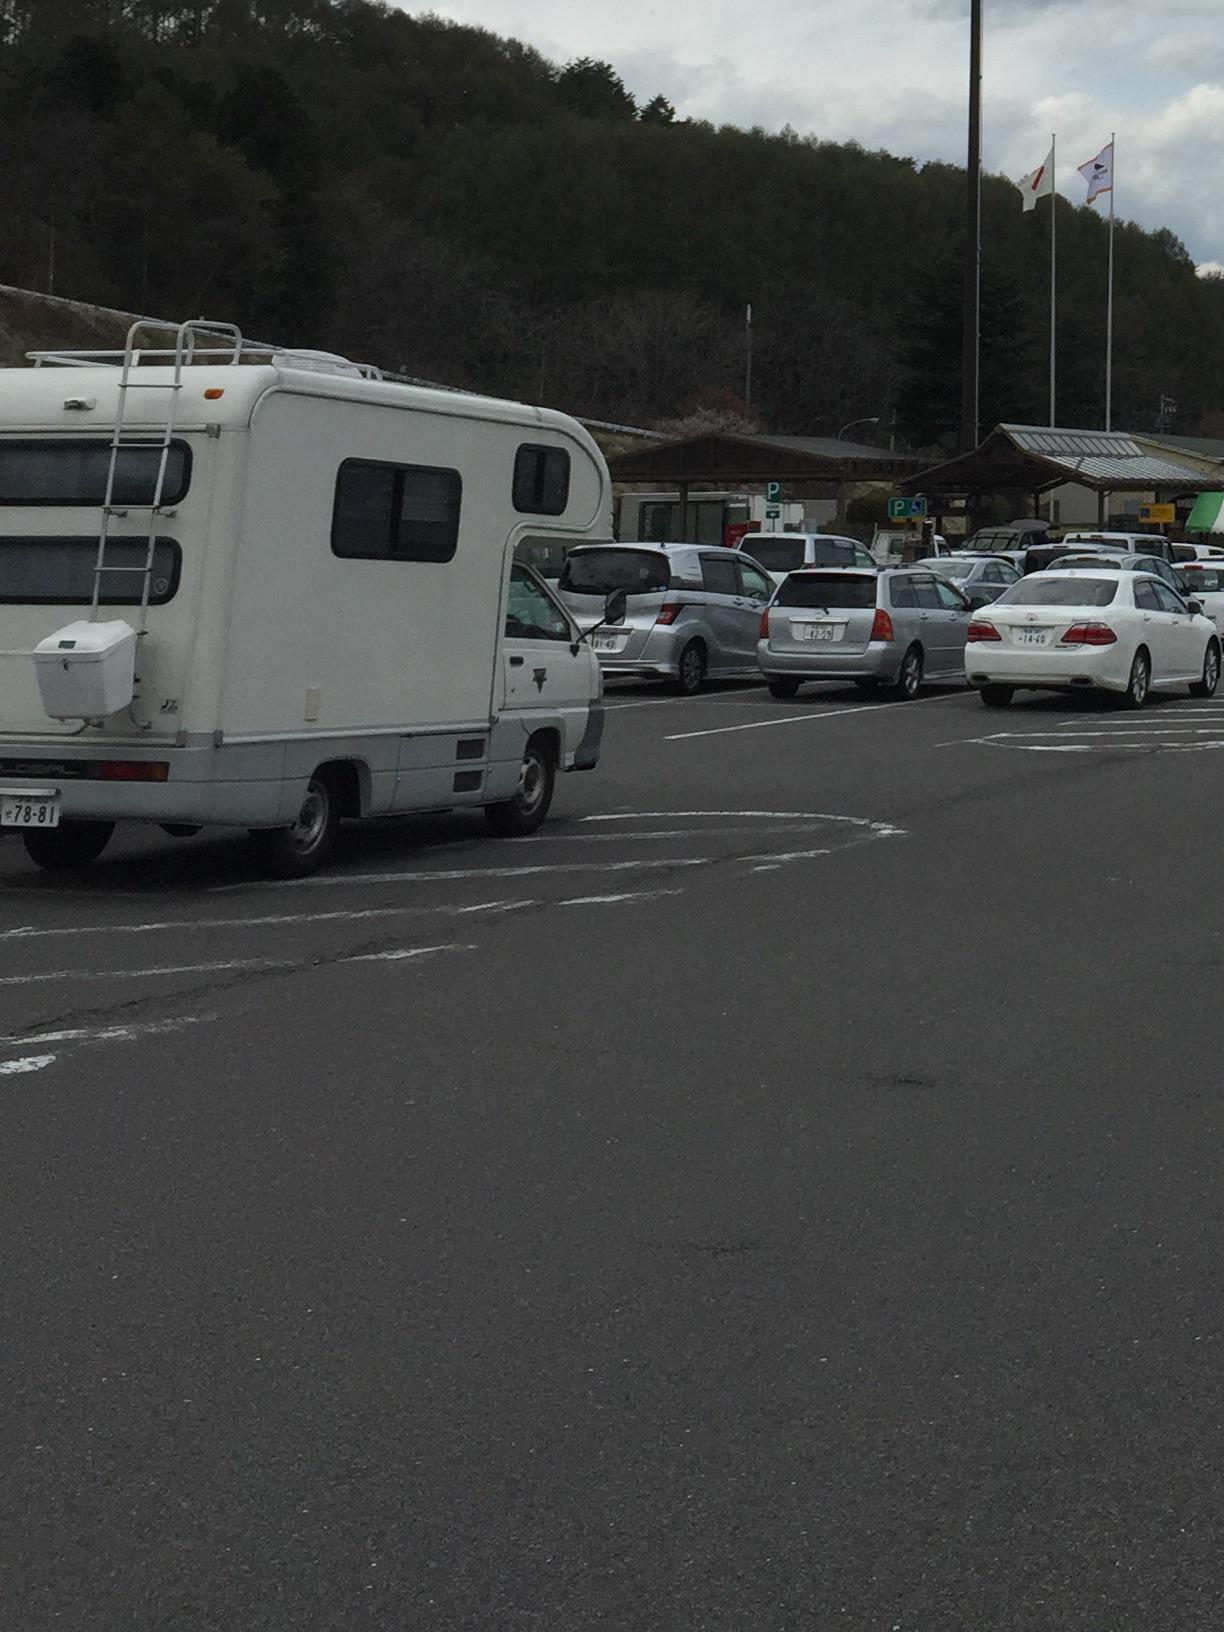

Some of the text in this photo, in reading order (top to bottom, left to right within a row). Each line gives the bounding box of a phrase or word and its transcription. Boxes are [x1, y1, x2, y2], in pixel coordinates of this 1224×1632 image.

[767, 482, 780, 500] P
[894, 500, 906, 515] P
[14, 805, 55, 824] 78-81
